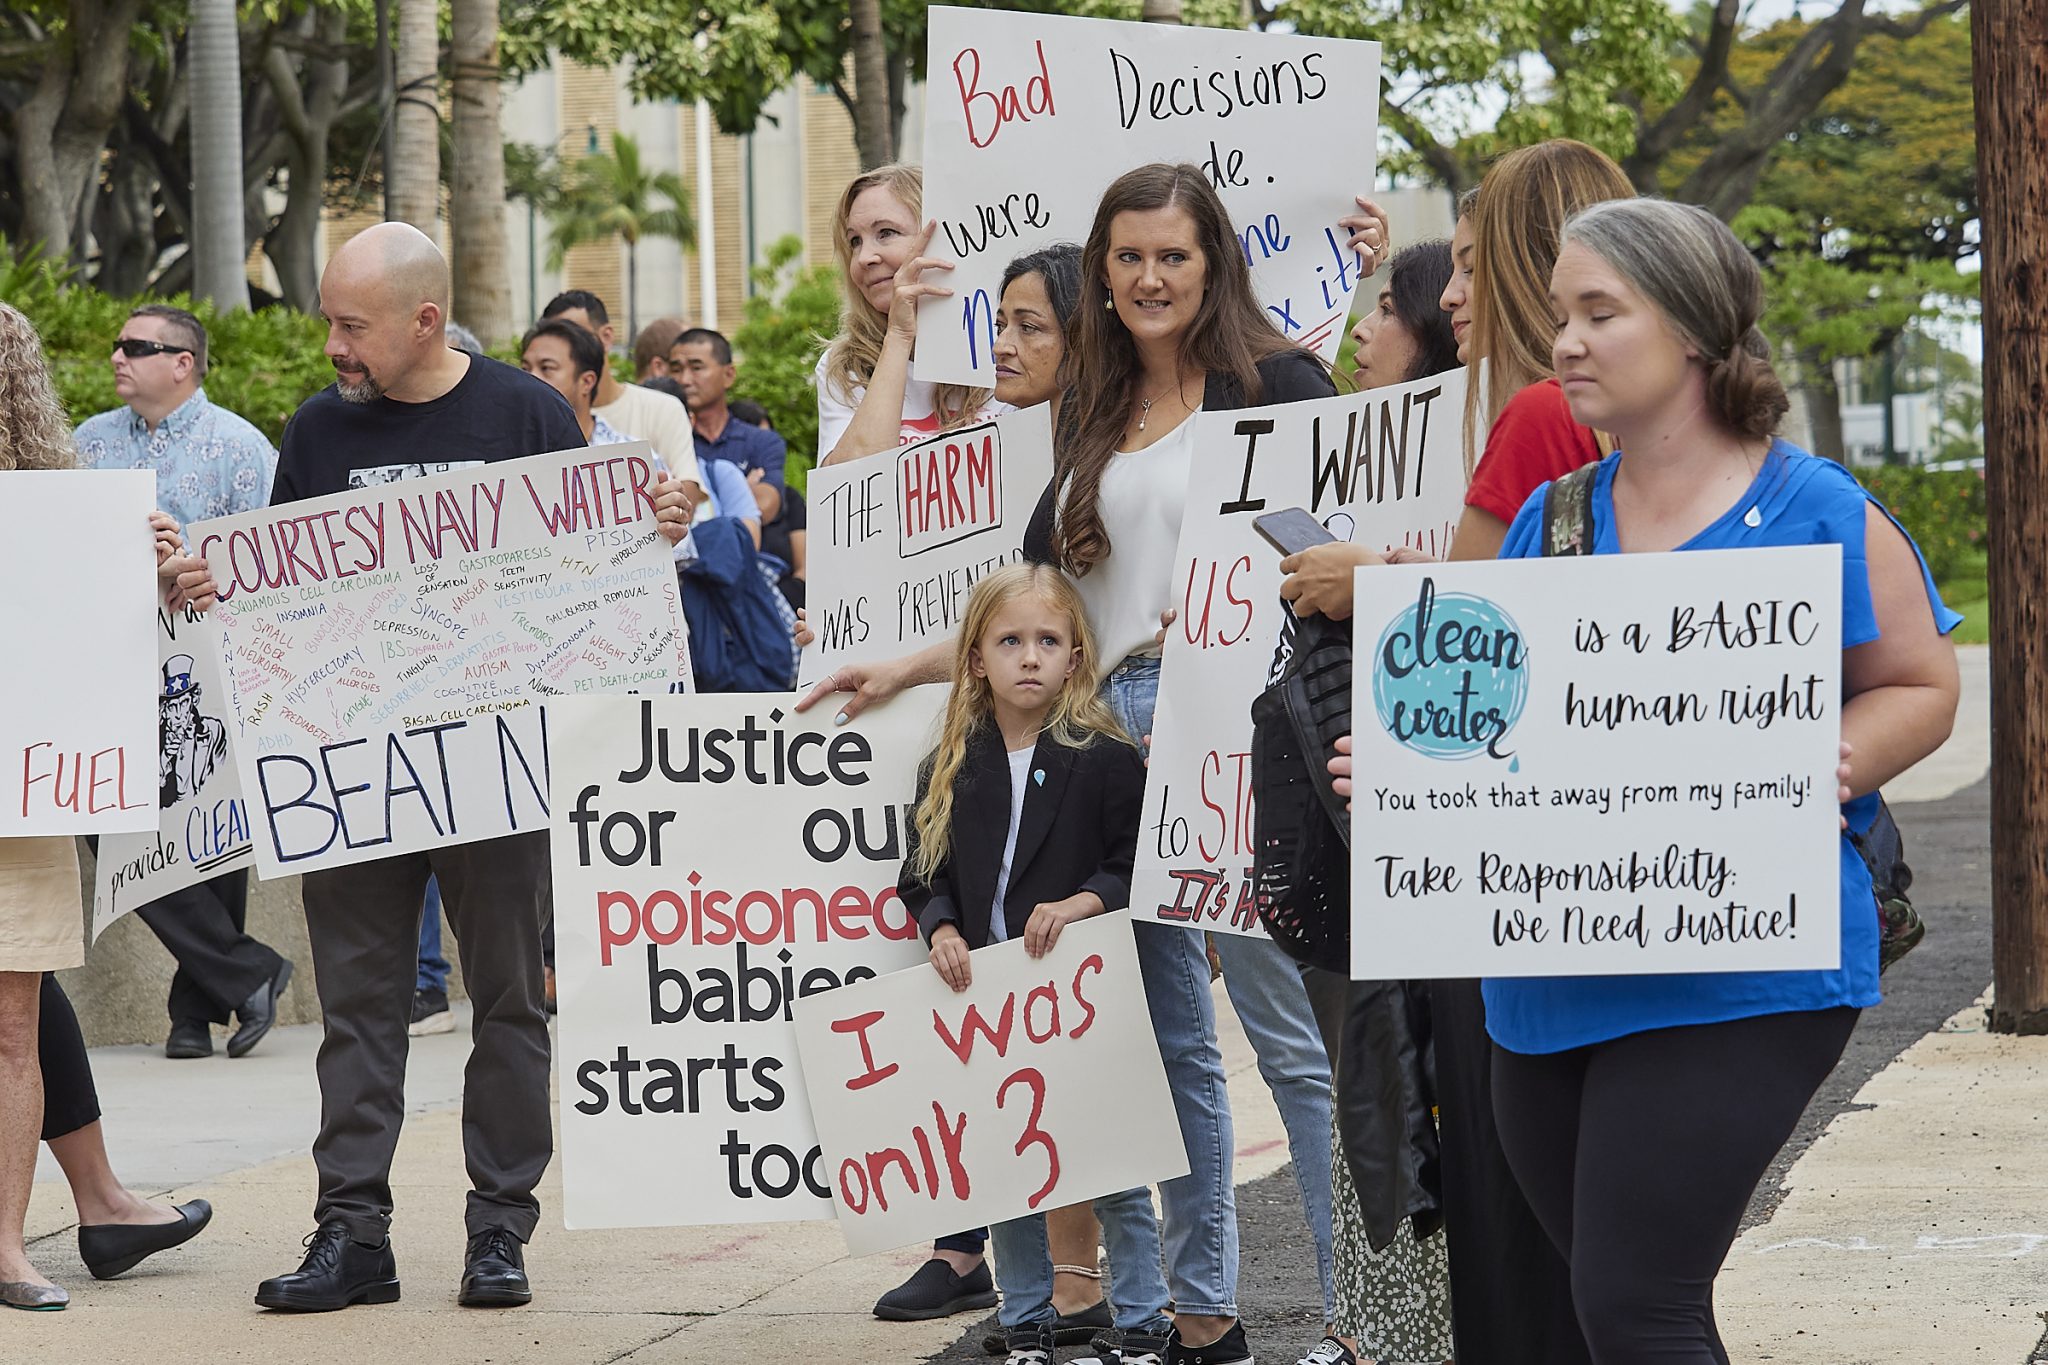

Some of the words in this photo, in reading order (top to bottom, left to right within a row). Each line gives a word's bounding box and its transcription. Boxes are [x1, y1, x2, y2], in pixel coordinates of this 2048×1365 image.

[952, 40, 1055, 148] Bad
[1110, 49, 1326, 129] Decisions
[942, 193, 1050, 258] were
[1218, 419, 1275, 515] I
[1311, 385, 1442, 514] WANT
[820, 472, 883, 548] THE
[903, 434, 996, 539] HARM
[199, 501, 385, 602] COURTESY
[398, 479, 505, 564] NAVY
[521, 456, 657, 538] WATER
[584, 529, 634, 552] PTSD
[609, 530, 660, 567] HYPERLIPIDEM
[413, 562, 439, 576] LOSS
[425, 572, 435, 582] OF
[459, 546, 552, 575] GASTROPARESIS
[560, 556, 599, 576] HTN
[229, 592, 290, 616] SQUAMOUS
[299, 586, 325, 601] CELL
[331, 572, 402, 596] CARCINOMA
[418, 575, 468, 596] SENSATION
[452, 578, 489, 615] NAUSEA
[494, 573, 552, 591] SENSITIVITY
[494, 582, 575, 609] VESTIBULAR
[581, 562, 665, 594] DYSFUNCTION
[603, 585, 649, 605] REMOVAL
[821, 596, 870, 654] WAS
[898, 547, 1024, 642] PREVENT
[1184, 555, 1253, 650] U.S.
[251, 617, 294, 650] SMALL
[277, 602, 327, 624] INSOMNIA
[373, 620, 440, 641] DEPRESSION
[410, 597, 469, 640] SYNCOPE
[1382, 577, 1529, 679] clean
[1575, 617, 1609, 654] is
[1623, 623, 1651, 654] a
[1666, 600, 1820, 654] BASIC
[252, 636, 286, 662] FIBER
[380, 640, 406, 664] IBS
[581, 649, 608, 671] LOSS
[589, 634, 627, 661] WEIGHT
[284, 645, 365, 705] HYSTERECTOMY
[336, 677, 381, 693] ALLERGIES
[350, 666, 376, 679] FOOD
[433, 680, 498, 699] COGNITIVE
[464, 659, 512, 681] AUTISM
[574, 678, 594, 693] PET
[247, 692, 273, 727] RASH
[402, 714, 437, 729] BASAL
[440, 710, 464, 723] CELL
[466, 699, 531, 718] CARCINOMA
[466, 685, 521, 703] DECLINE
[1565, 681, 1708, 731] human
[1718, 673, 1825, 731] right
[1388, 670, 1516, 760] water
[256, 733, 293, 753] ADHD
[618, 700, 873, 787] Justice
[22, 742, 149, 817] FUEL
[256, 721, 468, 863] BEAT
[1374, 786, 1417, 812] You
[1426, 781, 1479, 809] took
[1488, 781, 1542, 807] that
[1550, 787, 1611, 815] away
[1621, 782, 1678, 813] from
[1689, 783, 1723, 811] my
[1734, 774, 1812, 810] family!
[568, 784, 677, 867] for
[1150, 785, 1189, 859] to
[111, 831, 179, 913] provide
[1374, 855, 1462, 899] Take
[1492, 907, 1550, 947] We
[1562, 904, 1651, 949] Need
[1664, 893, 1797, 946] Justice!
[830, 1010, 900, 1090] I
[933, 953, 1104, 1065] was
[575, 1043, 785, 1116] starts
[996, 1067, 1061, 1210] 3
